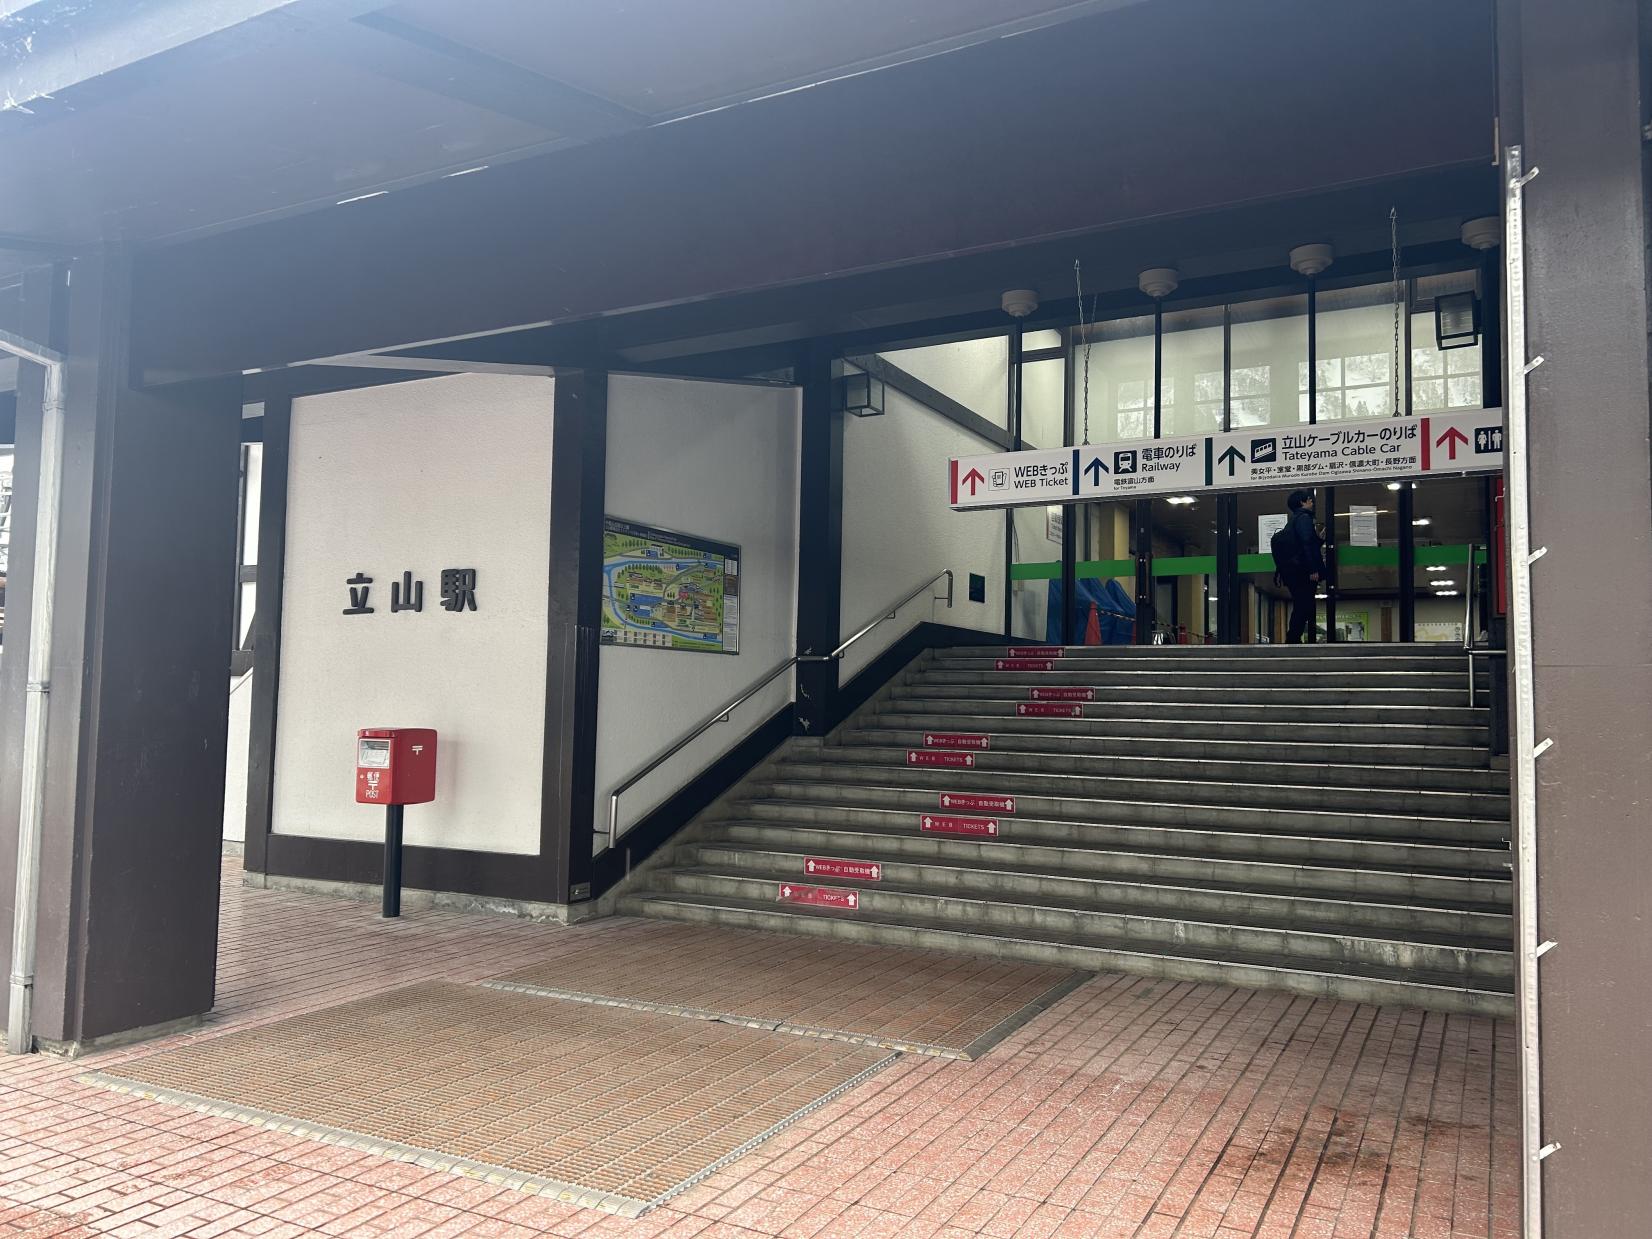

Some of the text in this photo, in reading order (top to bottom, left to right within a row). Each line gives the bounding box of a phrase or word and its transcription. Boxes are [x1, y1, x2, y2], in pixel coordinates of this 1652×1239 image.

[1281, 424, 1418, 450] 立山ケーブルカーのりば
[1141, 443, 1197, 461] 電車のりば
[1282, 443, 1402, 462] Tateyama Cable Car
[1014, 461, 1069, 478] WEBきっぷ
[1141, 461, 1181, 472] Railway
[1013, 477, 1069, 489] WEB Ticket
[342, 568, 478, 616] 立山駅
